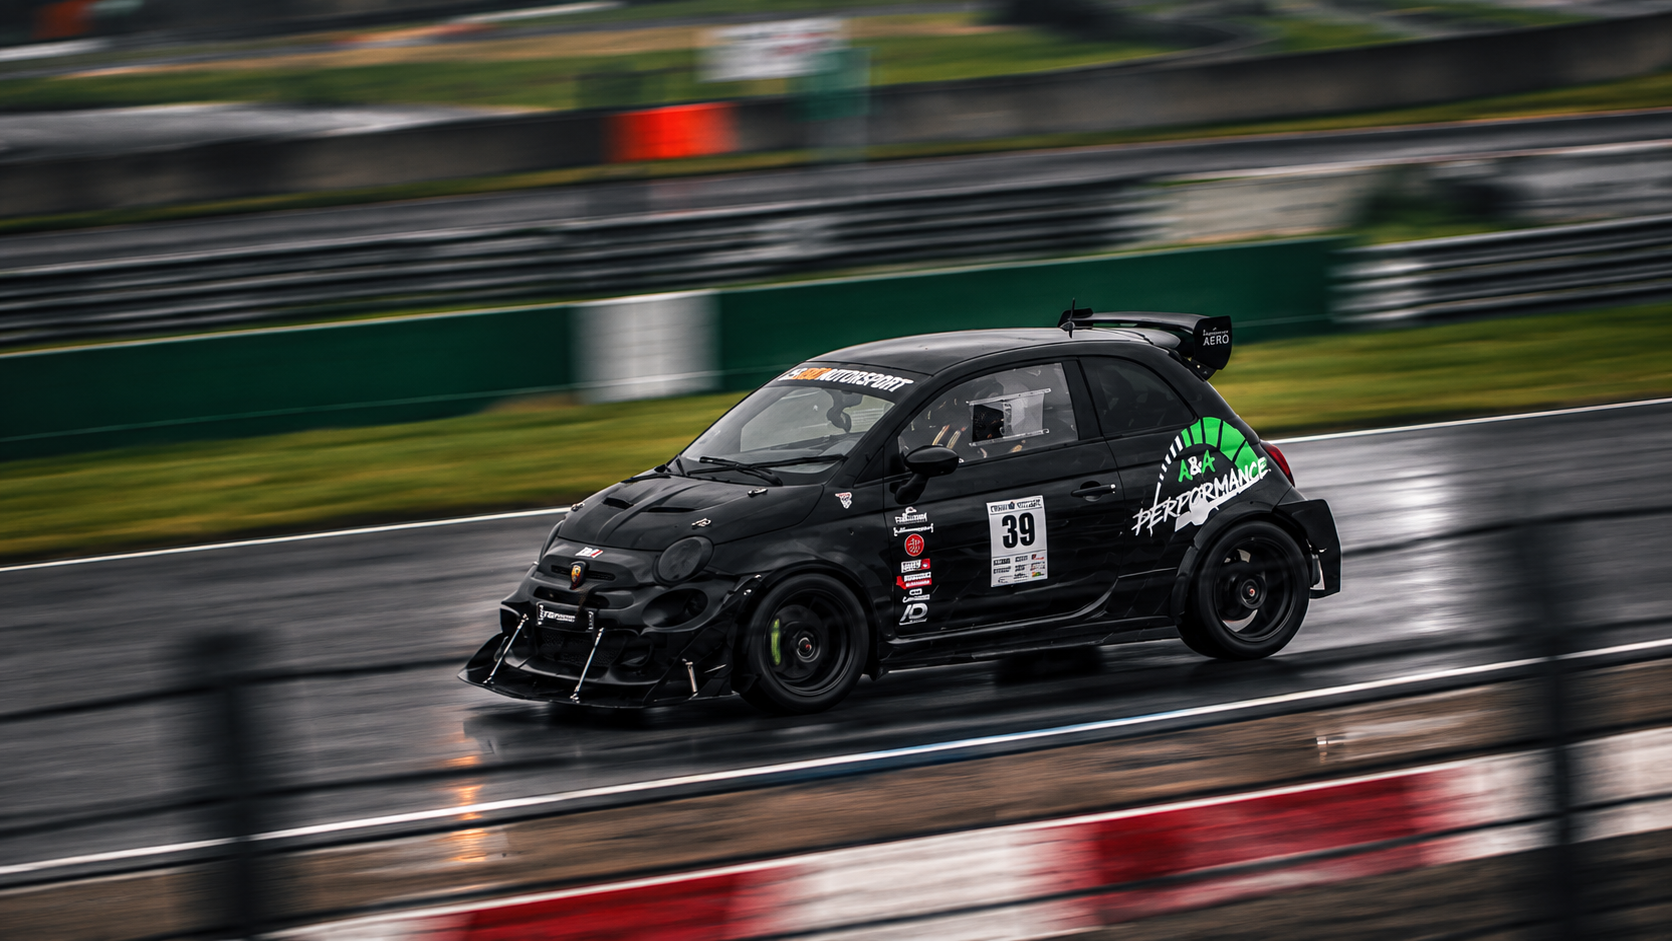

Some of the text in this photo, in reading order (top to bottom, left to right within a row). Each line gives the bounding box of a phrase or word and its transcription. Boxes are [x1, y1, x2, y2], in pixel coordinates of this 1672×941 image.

[1203, 335, 1230, 346] AERO
[1178, 450, 1215, 482] A&A
[1001, 513, 1036, 549] 39
